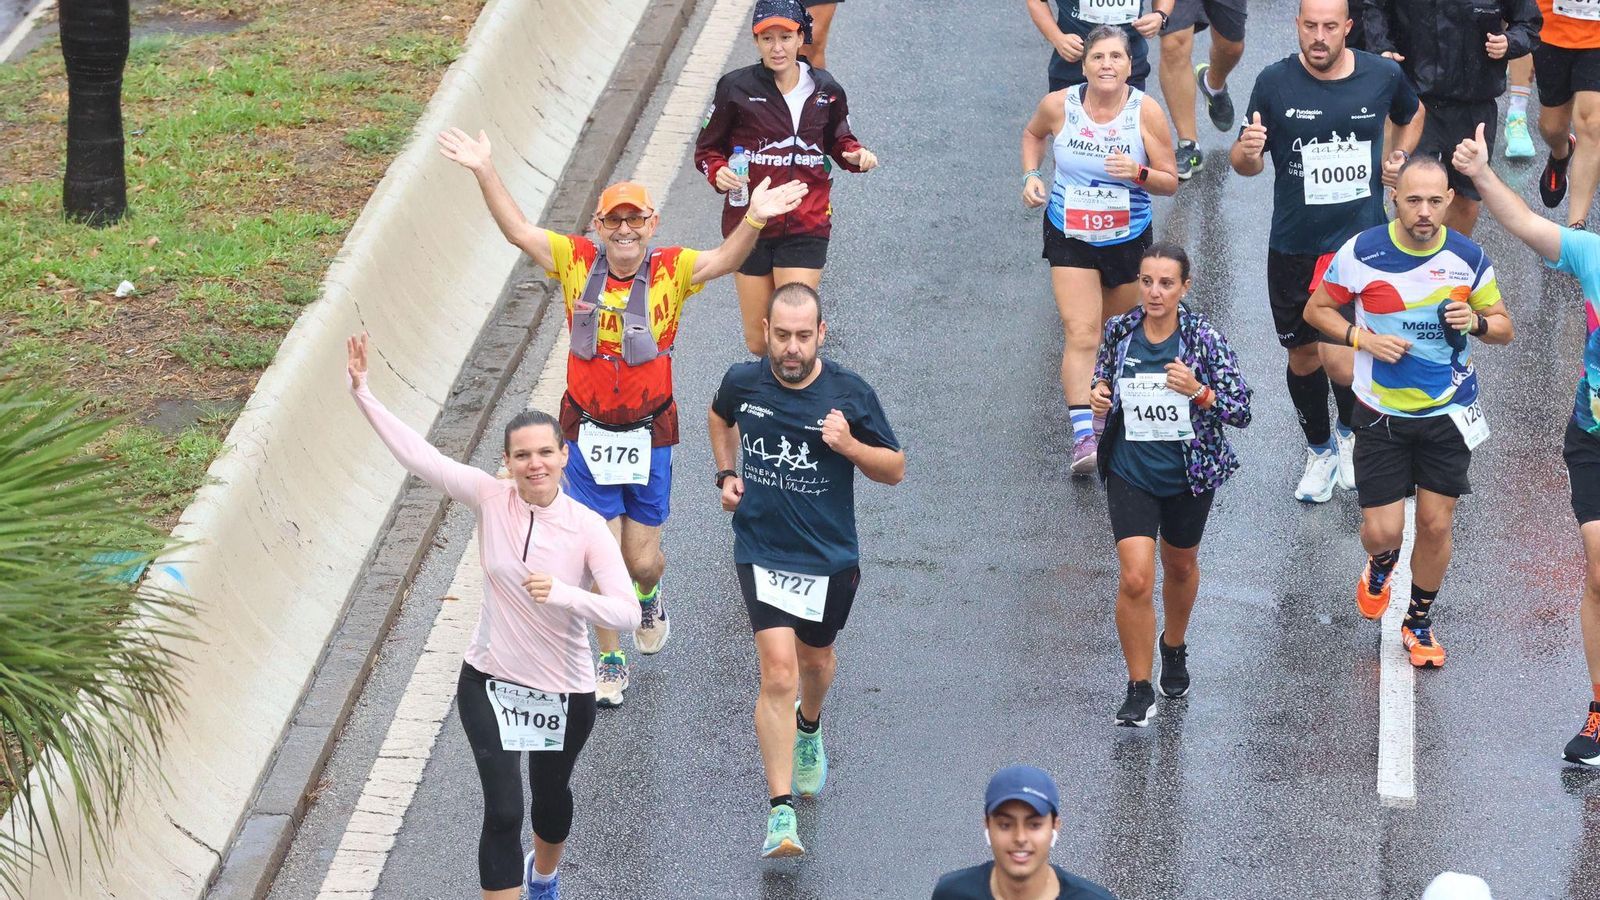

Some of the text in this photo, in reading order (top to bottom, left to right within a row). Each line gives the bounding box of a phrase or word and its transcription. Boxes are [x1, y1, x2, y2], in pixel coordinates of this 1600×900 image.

[1288, 161, 1303, 169] CAR
[1288, 168, 1304, 178] URB
[1311, 164, 1367, 184] 10008
[1082, 214, 1114, 230] 193
[598, 293, 669, 333] IA A!
[1402, 321, 1443, 331] Málag
[1416, 332, 1444, 340] 202
[1133, 405, 1179, 421] 1403
[590, 445, 639, 464] 5176
[767, 570, 816, 596] 3727
[501, 706, 560, 731] 11108
